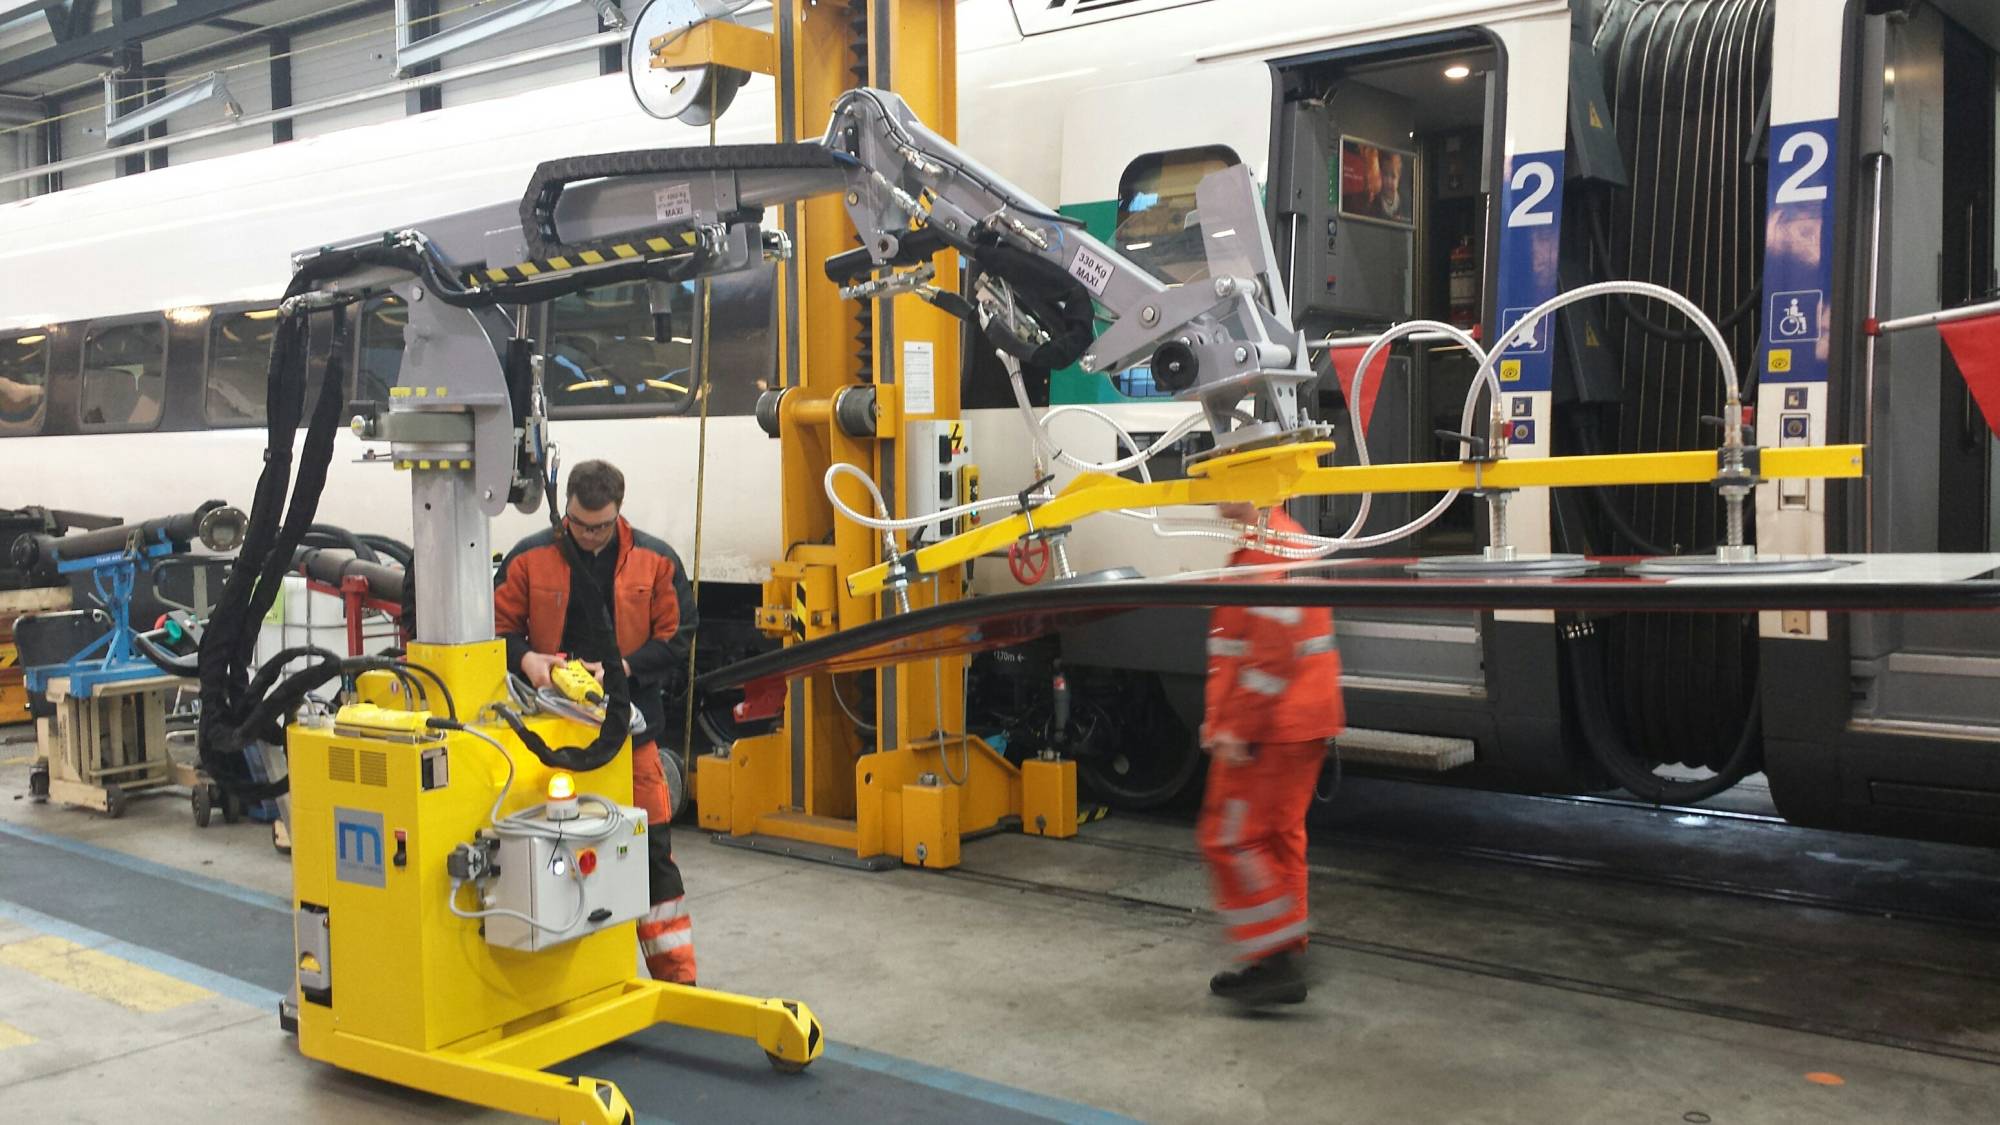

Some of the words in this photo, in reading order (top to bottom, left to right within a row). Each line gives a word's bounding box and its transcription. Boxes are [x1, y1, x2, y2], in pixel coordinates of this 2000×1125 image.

[1775, 131, 1829, 204] 2
[1507, 161, 1555, 228] 2
[665, 207, 684, 217] MAXI
[1076, 267, 1099, 287] MAXI
[1079, 253, 1095, 268] 330
[1095, 263, 1107, 279] Kg
